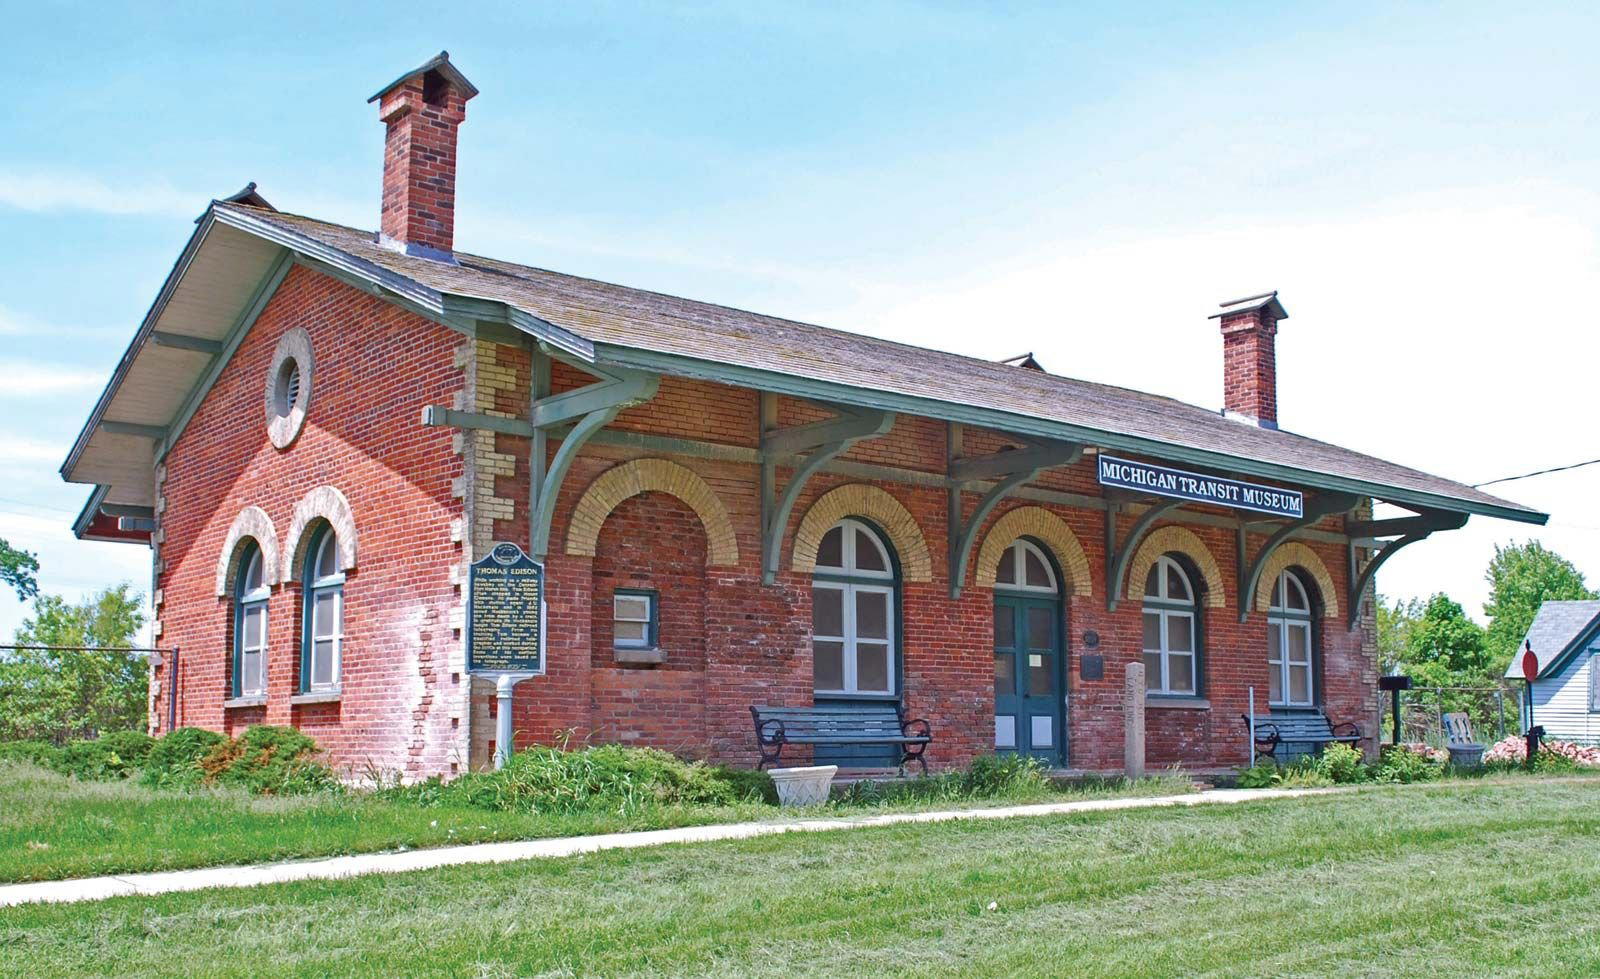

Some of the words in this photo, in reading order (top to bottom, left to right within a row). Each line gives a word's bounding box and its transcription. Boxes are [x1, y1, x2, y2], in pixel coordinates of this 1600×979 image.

[1102, 461, 1177, 490] MICHIGAN
[1179, 476, 1239, 501] TRANSIT
[1243, 489, 1300, 512] MUSEUM
[476, 567, 507, 575] THOMAS
